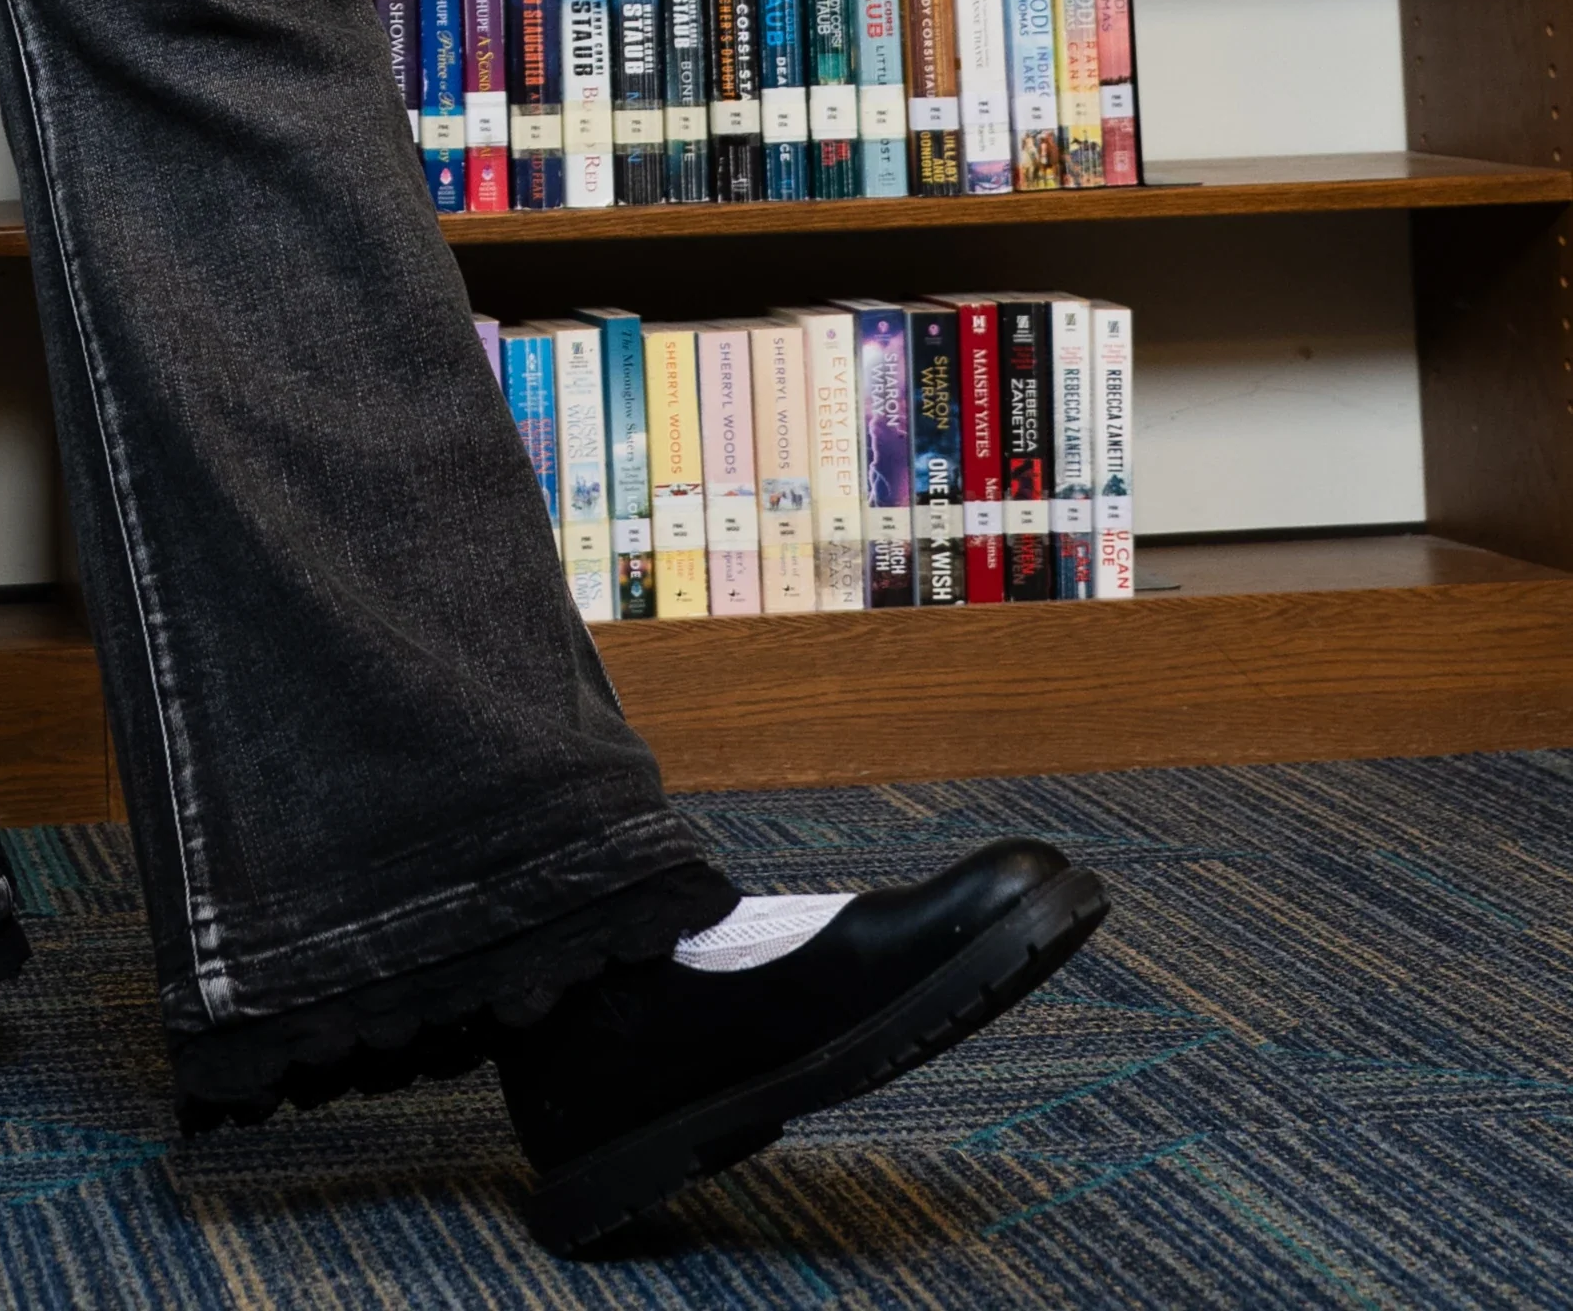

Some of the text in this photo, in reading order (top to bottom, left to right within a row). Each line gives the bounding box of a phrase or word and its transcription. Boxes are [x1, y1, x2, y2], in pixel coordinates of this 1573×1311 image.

[523, 9, 545, 86] SLAUGHTER
[571, 0, 595, 77] STAUB
[736, 4, 749, 61] CORSI
[622, 330, 638, 463] The Moonglow Sisters
[719, 342, 736, 475] SHERRYL WOODS
[818, 387, 833, 468] DESIRE
[832, 356, 850, 496] EVERY DEEP
[921, 367, 935, 419] WRAY
[934, 355, 950, 429] SHARON
[972, 348, 989, 458] MAISEY YATES
[1105, 369, 1124, 474] REBECCA ZANETTI
[928, 457, 950, 495] ONE
[931, 551, 952, 600] WISH
